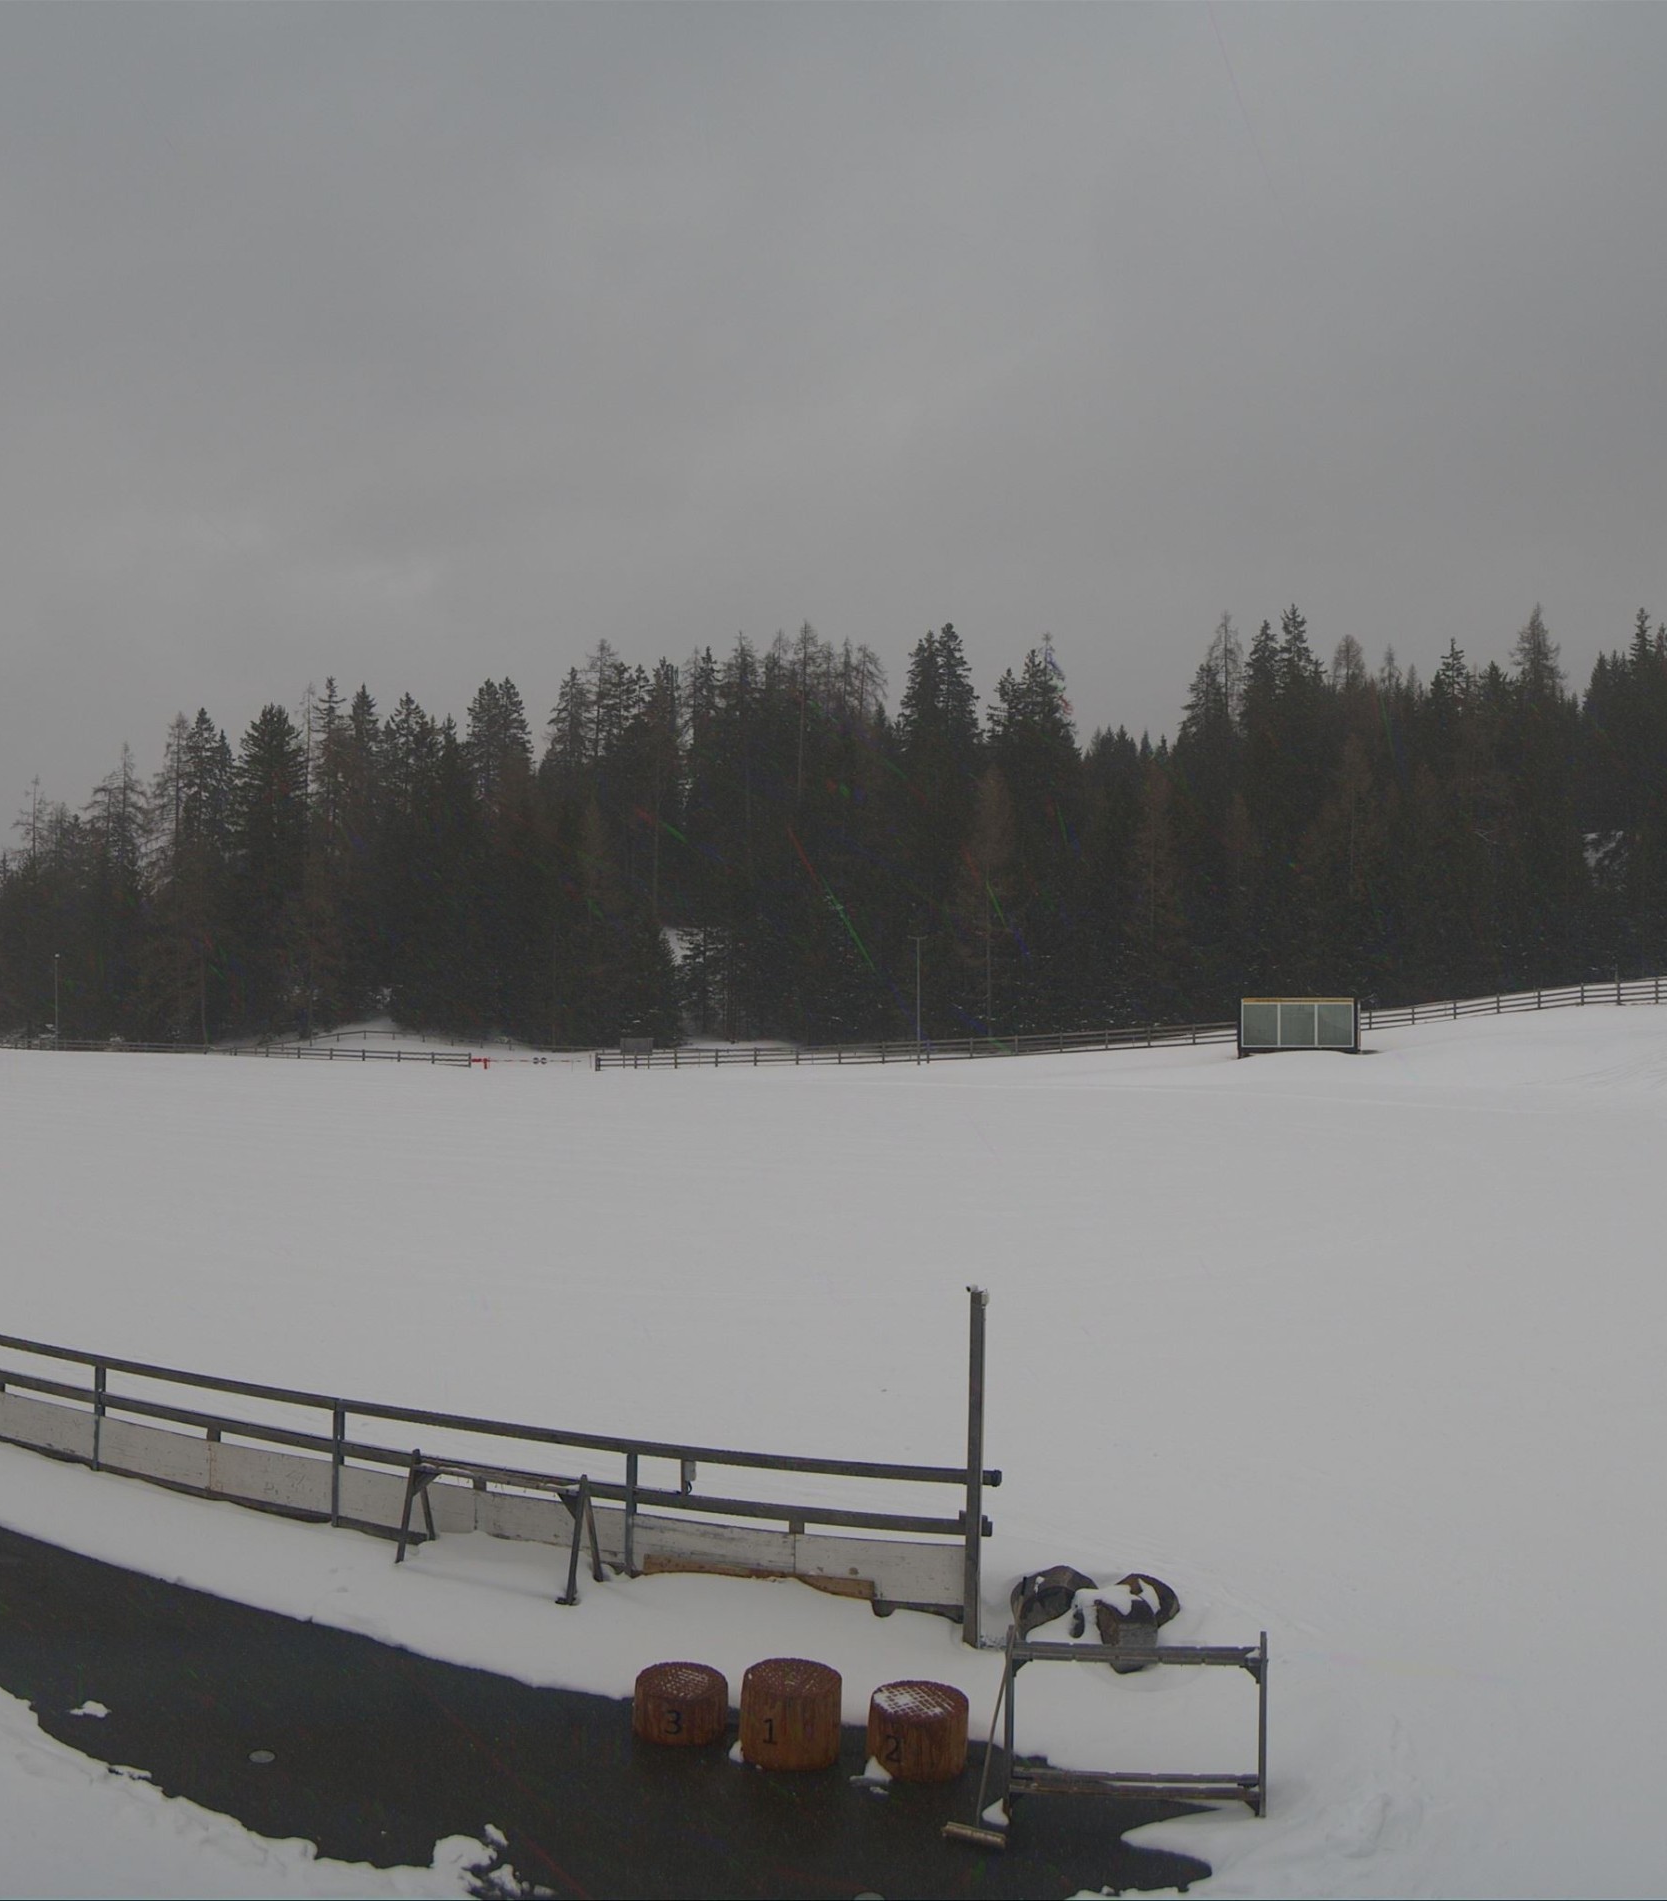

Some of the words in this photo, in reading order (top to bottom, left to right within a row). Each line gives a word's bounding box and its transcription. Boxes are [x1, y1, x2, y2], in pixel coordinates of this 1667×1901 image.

[664, 1710, 683, 1735] 3
[763, 1718, 777, 1745] 1
[884, 1734, 903, 1762] 2
